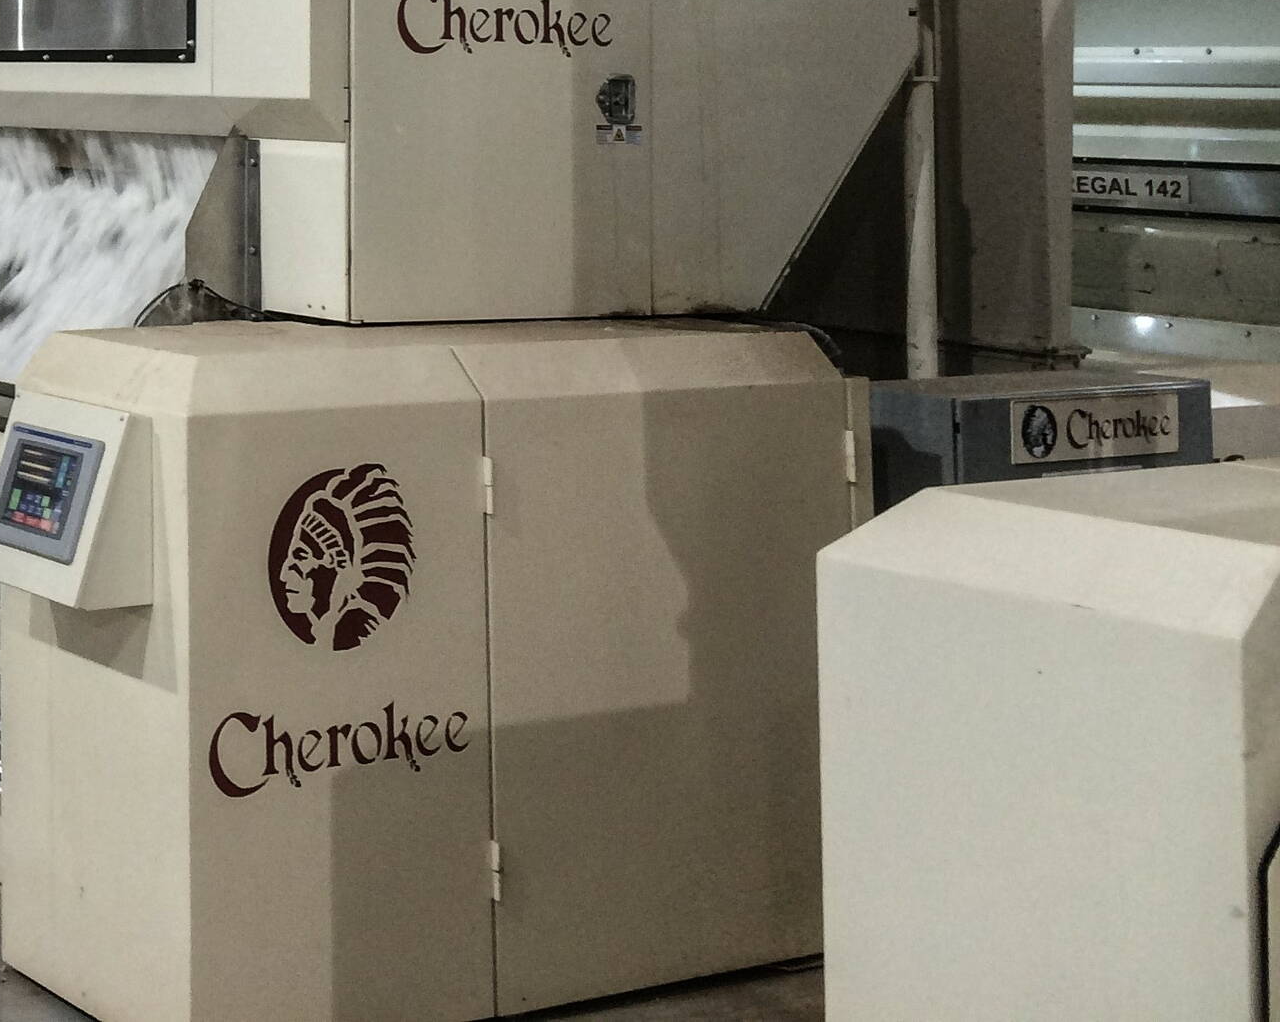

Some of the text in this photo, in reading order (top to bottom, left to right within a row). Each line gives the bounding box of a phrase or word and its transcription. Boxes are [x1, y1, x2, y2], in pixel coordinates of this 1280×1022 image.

[1072, 176, 1182, 199] EGAL 142
[1066, 408, 1171, 449] Cherokee
[208, 700, 470, 798] Cherokee
